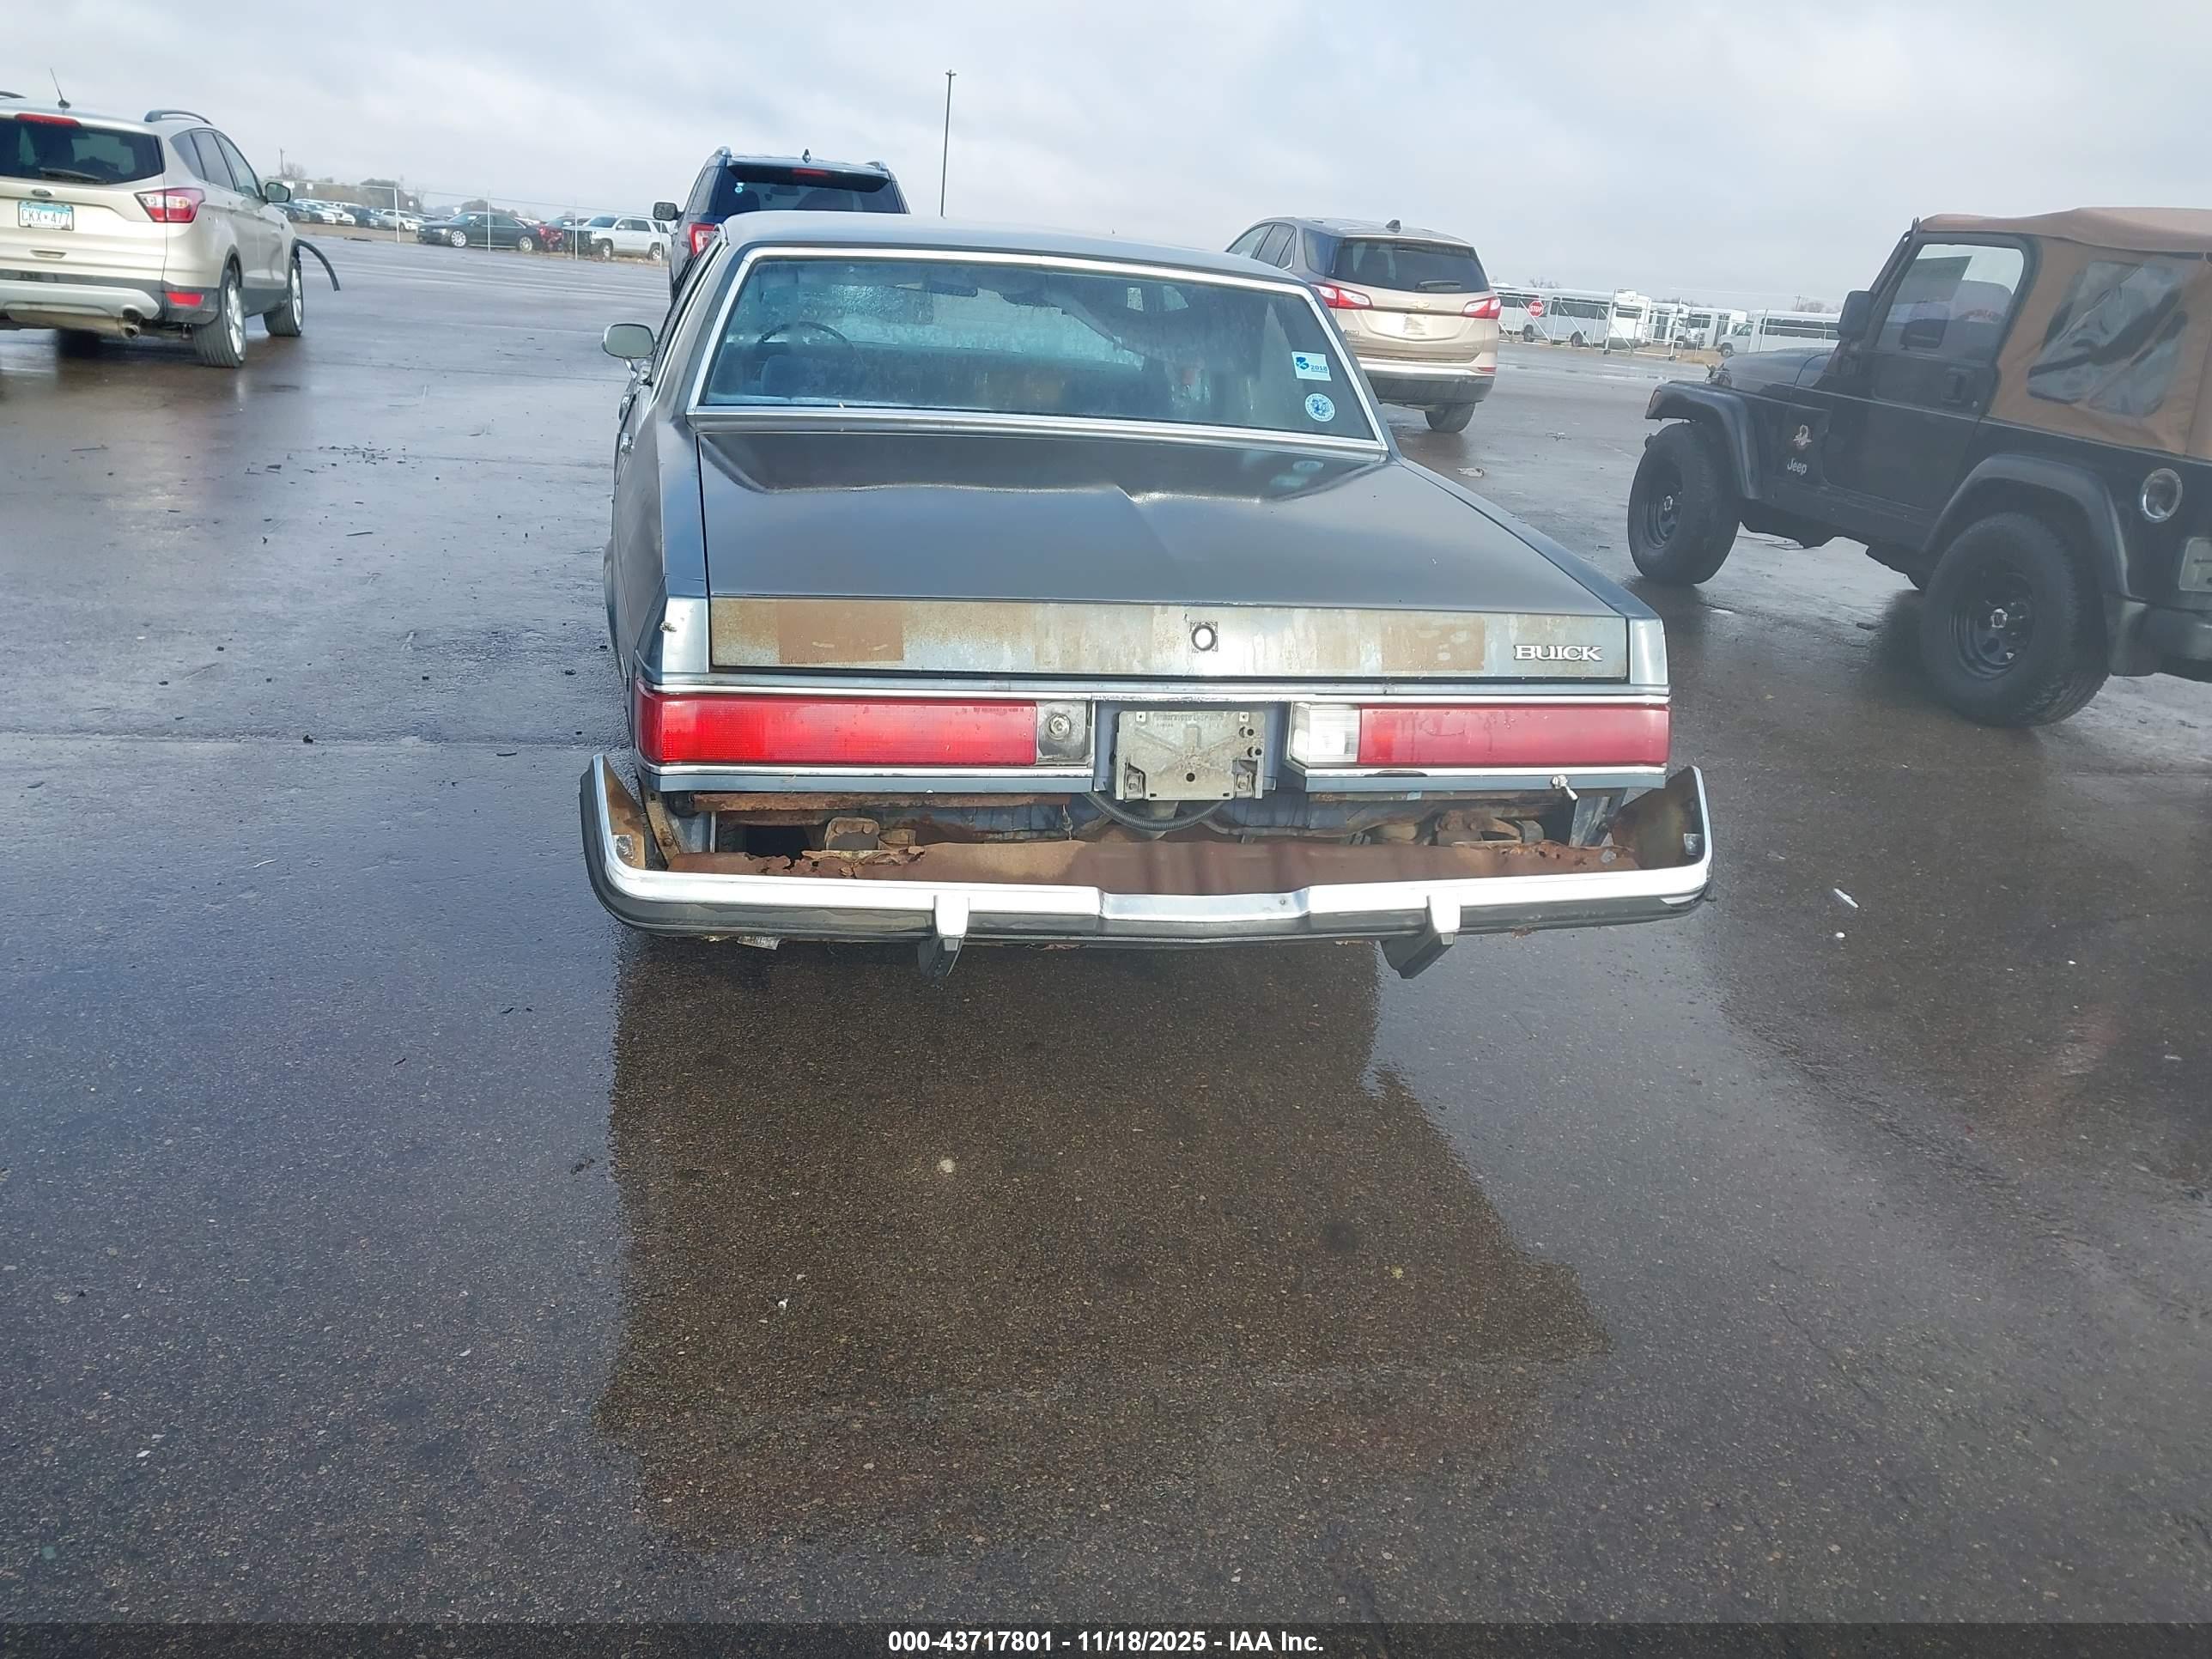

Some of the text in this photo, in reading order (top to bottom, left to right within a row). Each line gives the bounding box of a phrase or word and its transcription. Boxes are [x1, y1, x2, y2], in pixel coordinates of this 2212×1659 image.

[21, 209, 70, 226] CKX 477
[1787, 458, 1807, 476] Jeep
[1514, 645, 1603, 661] BUICK
